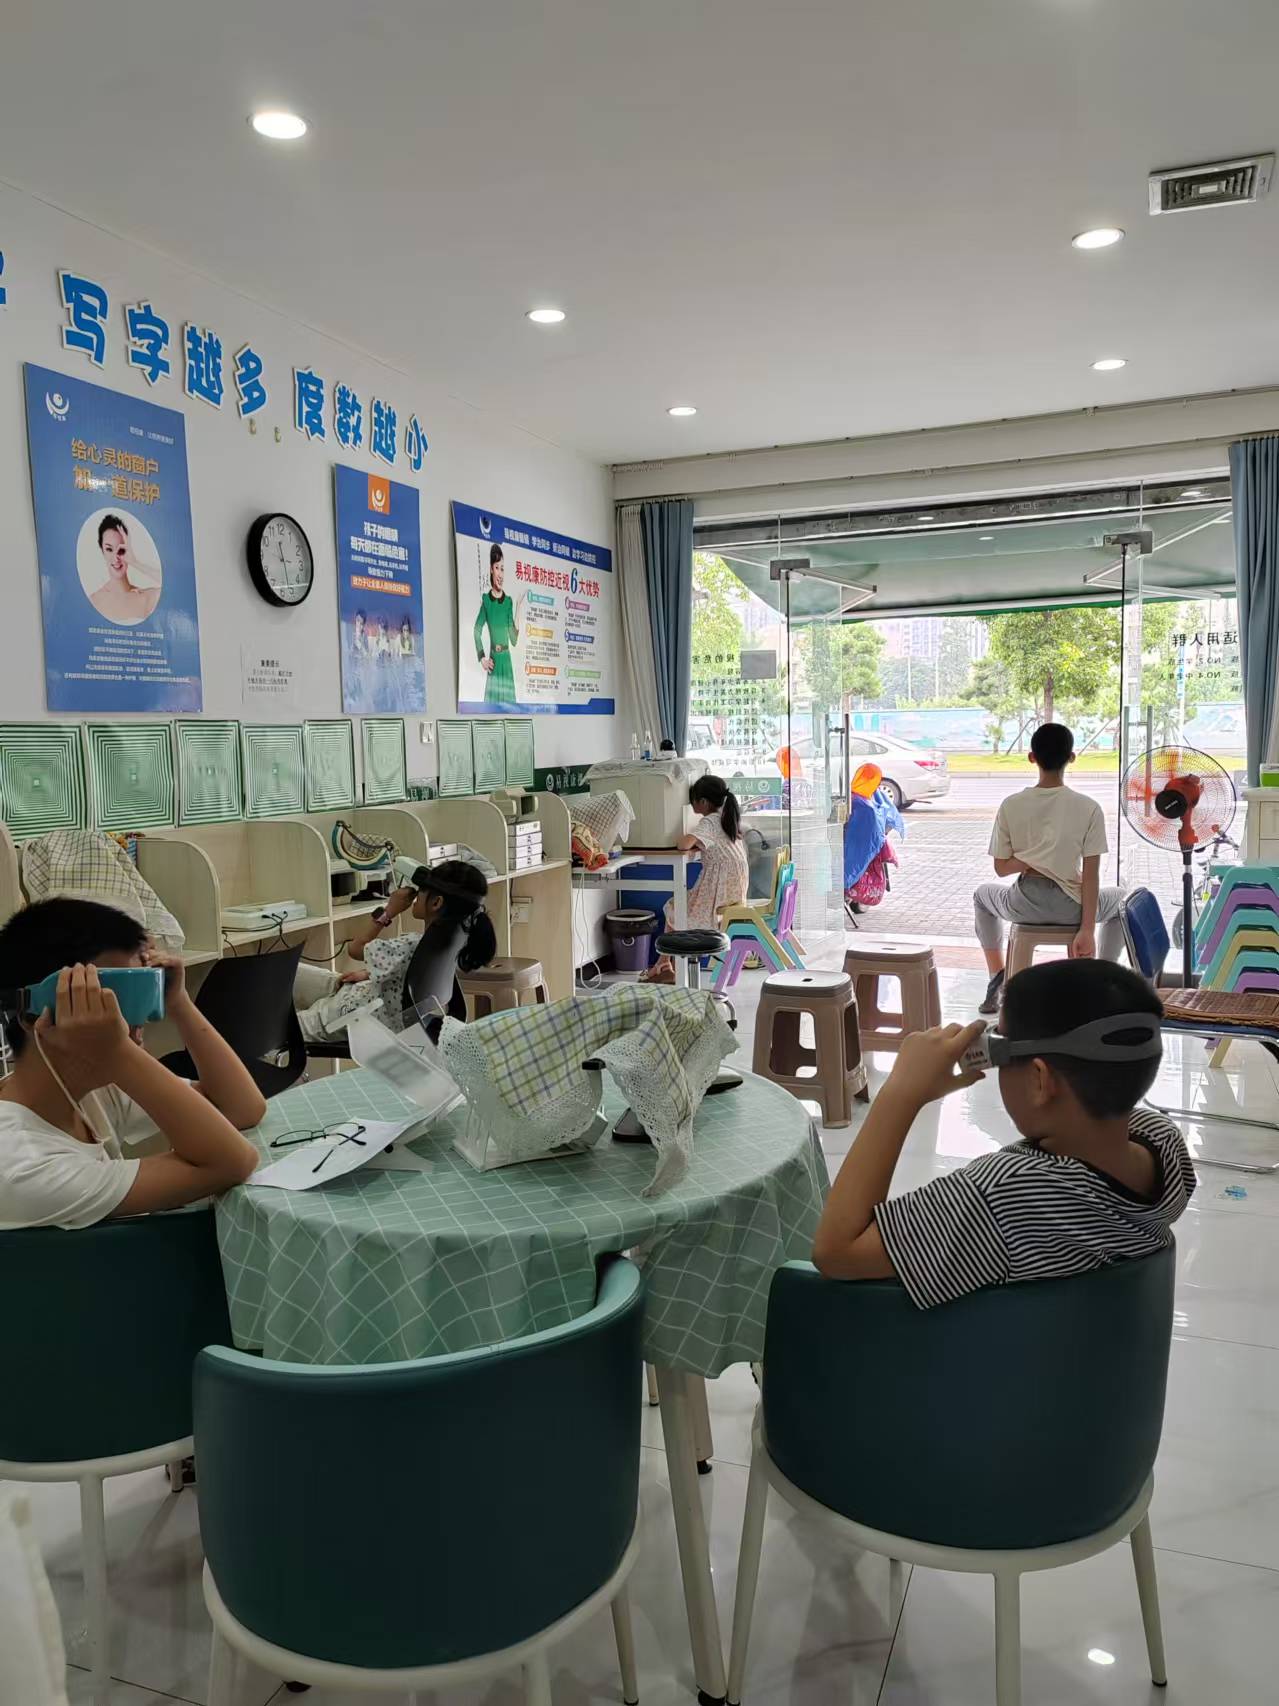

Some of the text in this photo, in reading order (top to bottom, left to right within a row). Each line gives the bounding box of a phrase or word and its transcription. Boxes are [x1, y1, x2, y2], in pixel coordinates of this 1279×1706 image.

[58, 269, 268, 420] 写字越多
[293, 365, 429, 473] 度数越小
[71, 437, 159, 476] 给心灵的窗户
[515, 560, 600, 598] 易视康防控近视6大优势
